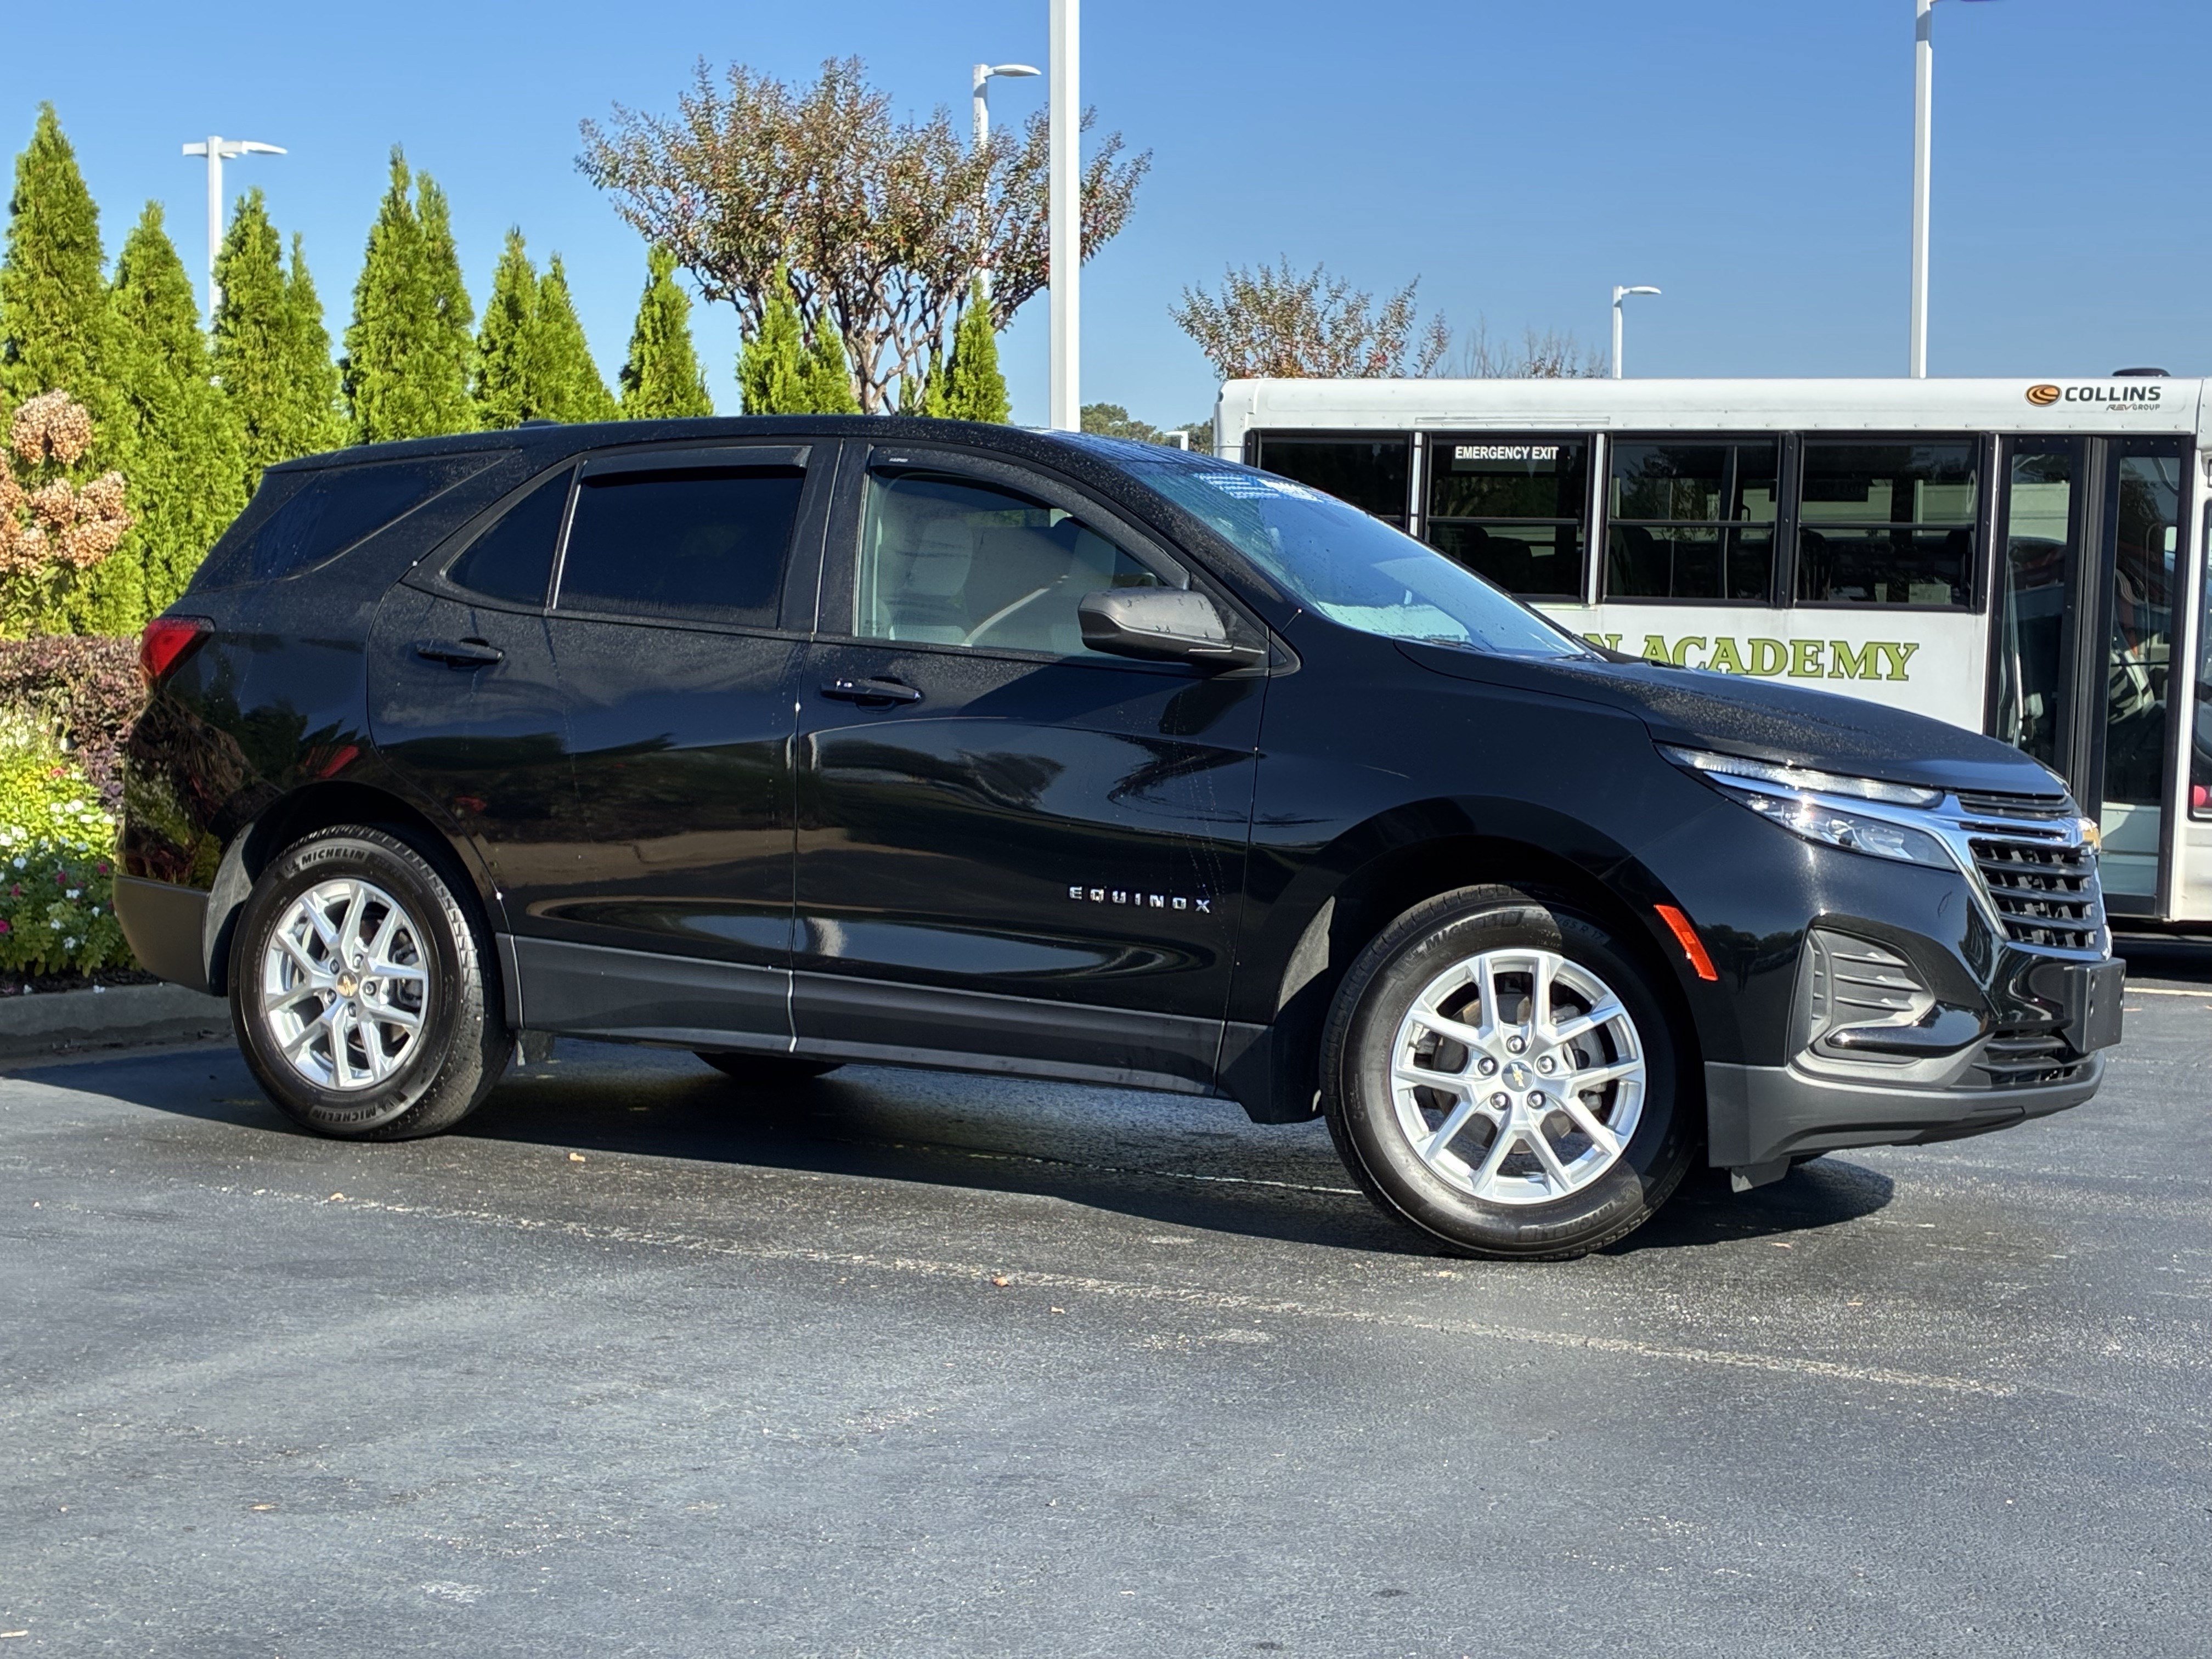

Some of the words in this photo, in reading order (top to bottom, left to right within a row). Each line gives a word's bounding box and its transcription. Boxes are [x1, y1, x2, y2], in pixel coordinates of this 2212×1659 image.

[2065, 386, 2161, 402] COLLINS
[1455, 446, 1530, 459] EMERGENCY
[1532, 446, 1559, 460] EXIT
[1645, 635, 1919, 681] ACADEMY
[302, 848, 365, 865] MICHELIN
[1069, 885, 1210, 913] EQUINOX
[312, 1105, 377, 1122] MICHELIN
